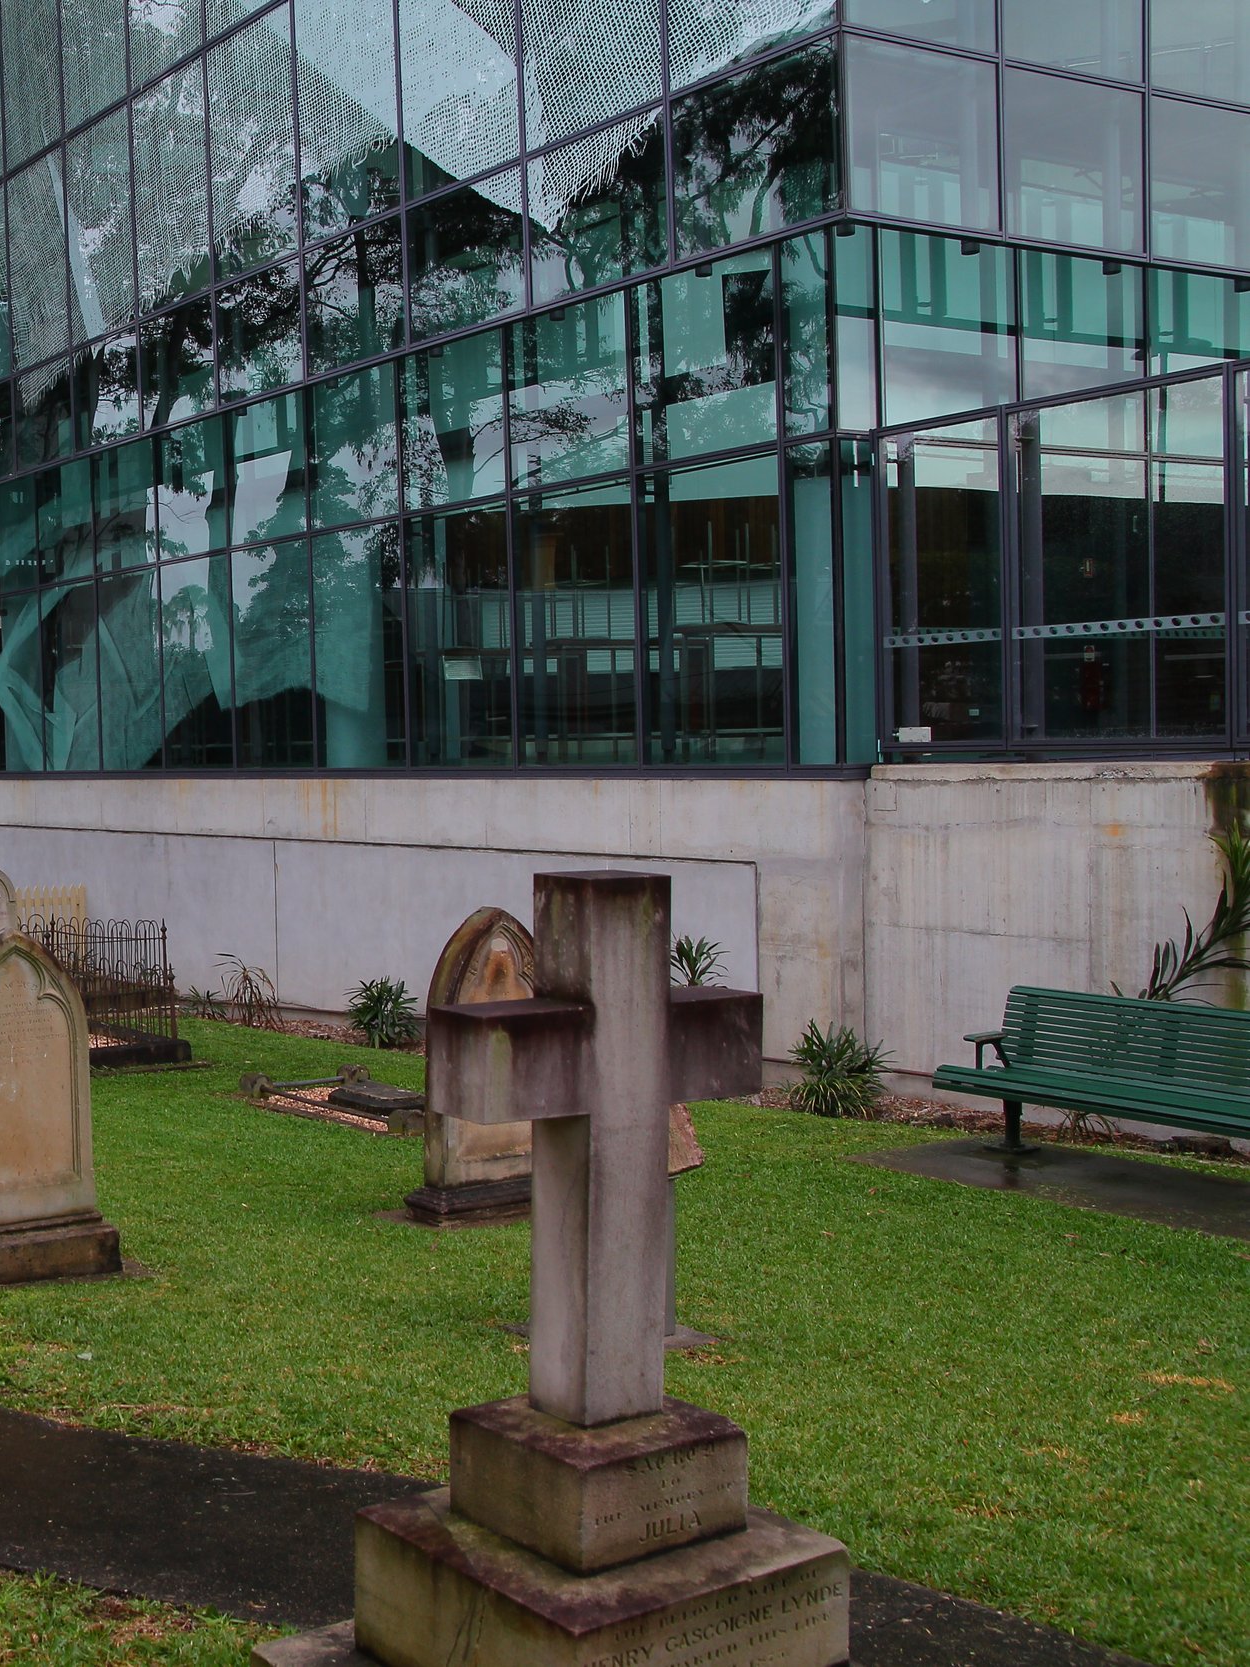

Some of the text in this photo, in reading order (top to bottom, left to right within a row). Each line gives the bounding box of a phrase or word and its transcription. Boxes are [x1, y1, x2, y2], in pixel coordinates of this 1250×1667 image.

[639, 1509, 702, 1542] JULIA
[665, 1604, 773, 1653] GASCOIGNE
[781, 1581, 843, 1614] LYNDE
